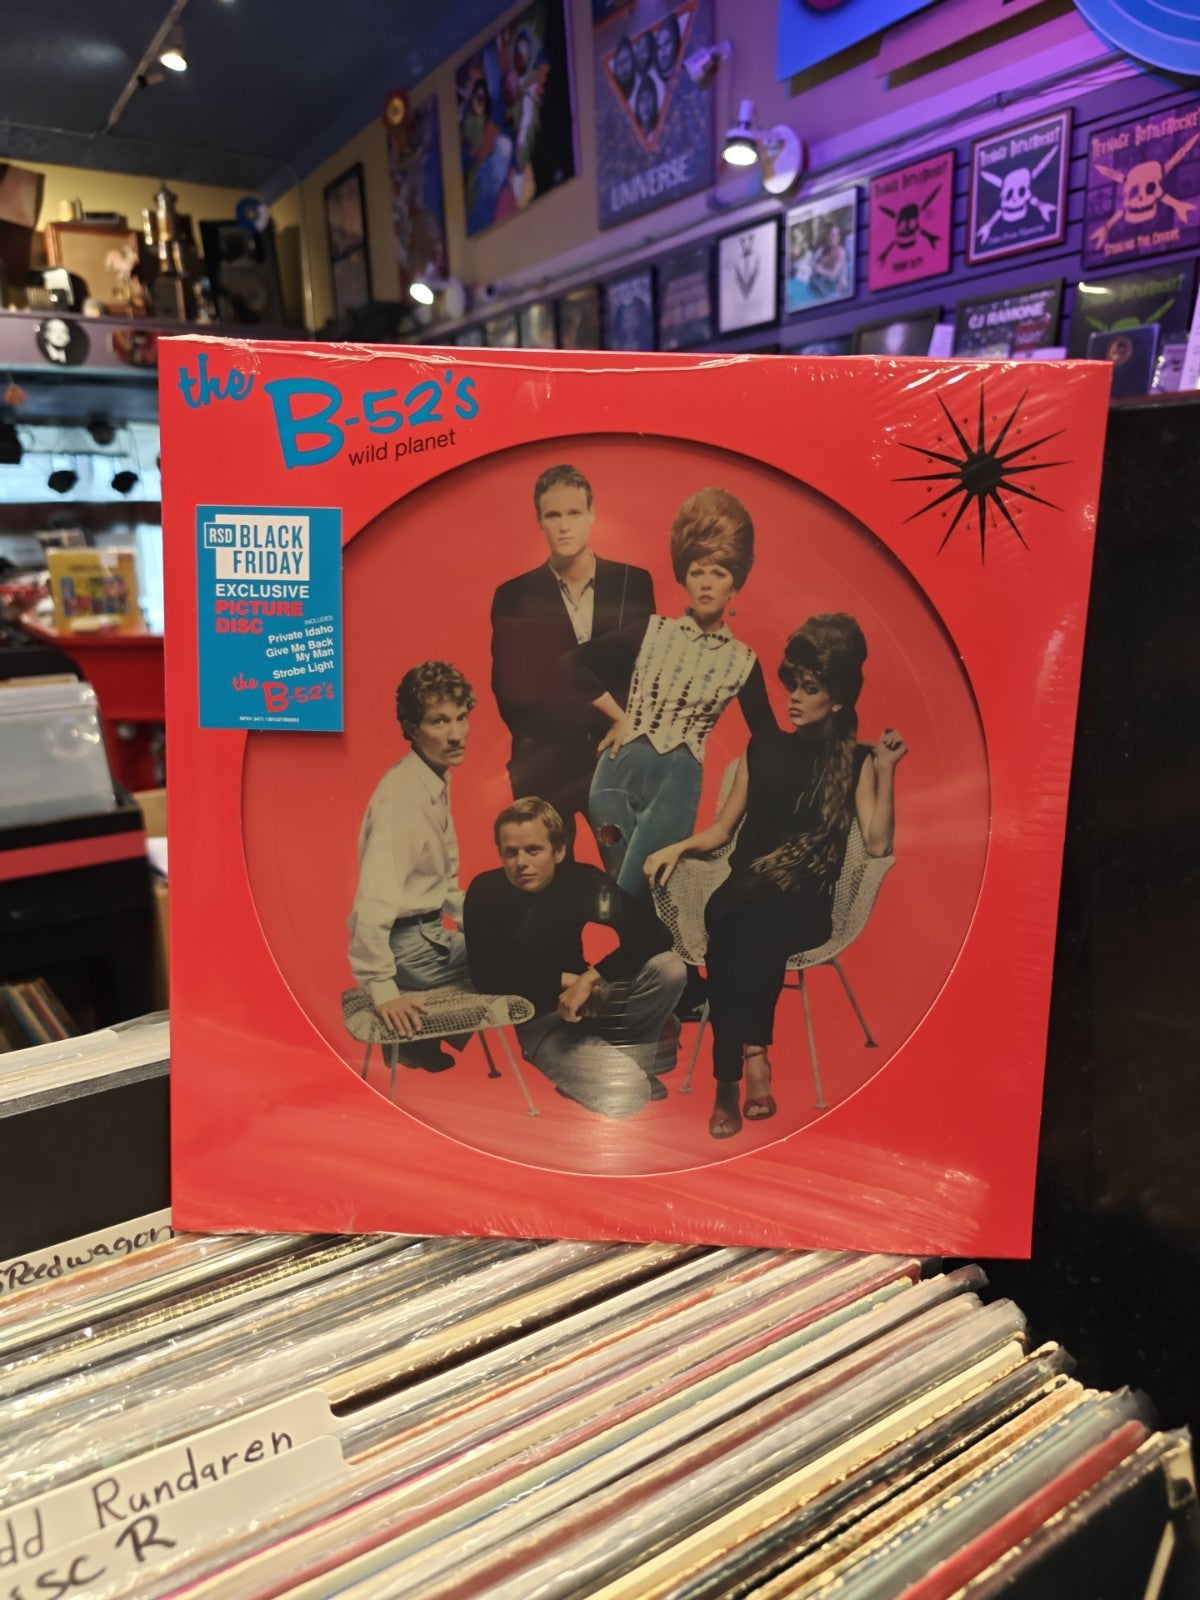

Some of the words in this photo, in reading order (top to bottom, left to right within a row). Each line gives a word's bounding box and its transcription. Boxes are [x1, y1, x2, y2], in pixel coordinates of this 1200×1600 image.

[178, 353, 254, 409] the
[263, 370, 479, 469] B-52's
[349, 441, 387, 466] wild
[395, 429, 456, 461] planet
[209, 527, 233, 544] RSD
[240, 524, 303, 549] BLACK
[233, 550, 303, 574] FRIDAY
[215, 583, 310, 598] EXCLUSIVE
[215, 600, 304, 616] PICTURE
[215, 618, 263, 634] DISC
[268, 631, 303, 644] Private
[305, 625, 334, 637] Idaho
[266, 646, 289, 658] Give
[291, 642, 305, 653] Me
[308, 637, 334, 650] Back
[295, 652, 310, 662] My
[312, 647, 334, 659] Man
[272, 666, 306, 679] Strobe
[308, 660, 335, 673] Light
[232, 672, 259, 691] the
[262, 681, 335, 713] B-52's
[115, 1515, 177, 1562] R
